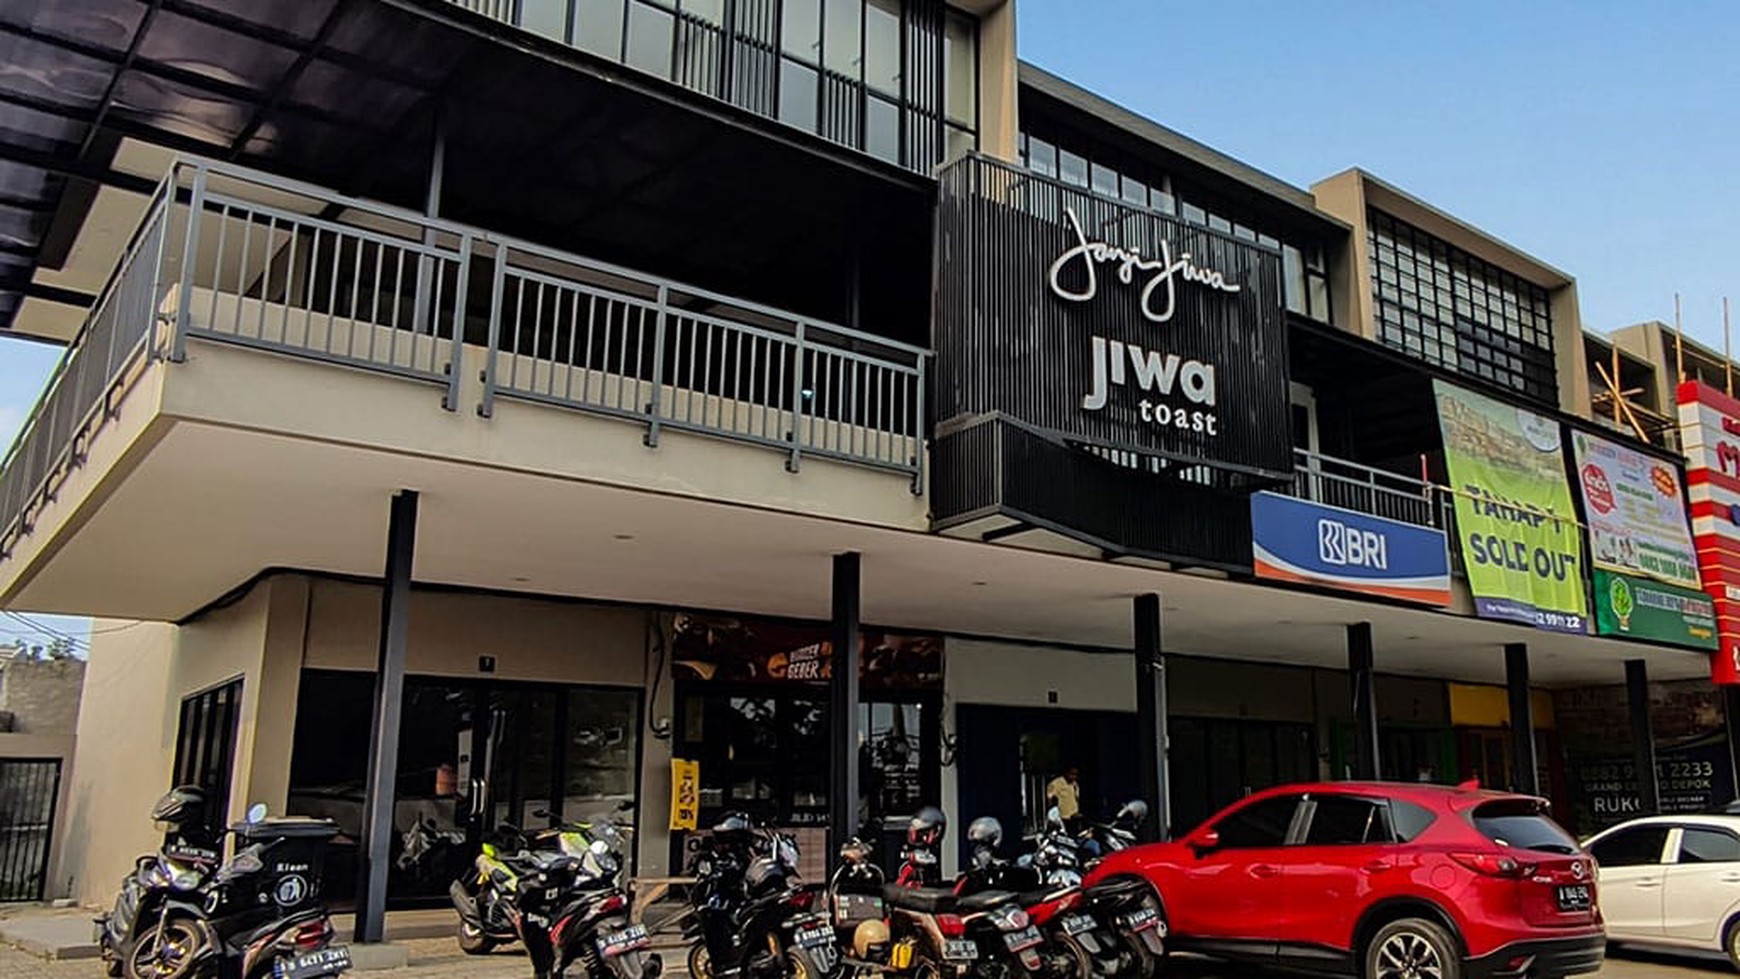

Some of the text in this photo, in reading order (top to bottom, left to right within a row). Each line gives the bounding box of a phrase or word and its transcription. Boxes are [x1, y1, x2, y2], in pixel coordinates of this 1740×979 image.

[1141, 239, 1240, 322] Jiwa
[1139, 400, 1216, 435] toast
[1346, 527, 1388, 570] BRI
[1469, 532, 1529, 572] SOLD
[1671, 761, 1714, 778] 2233
